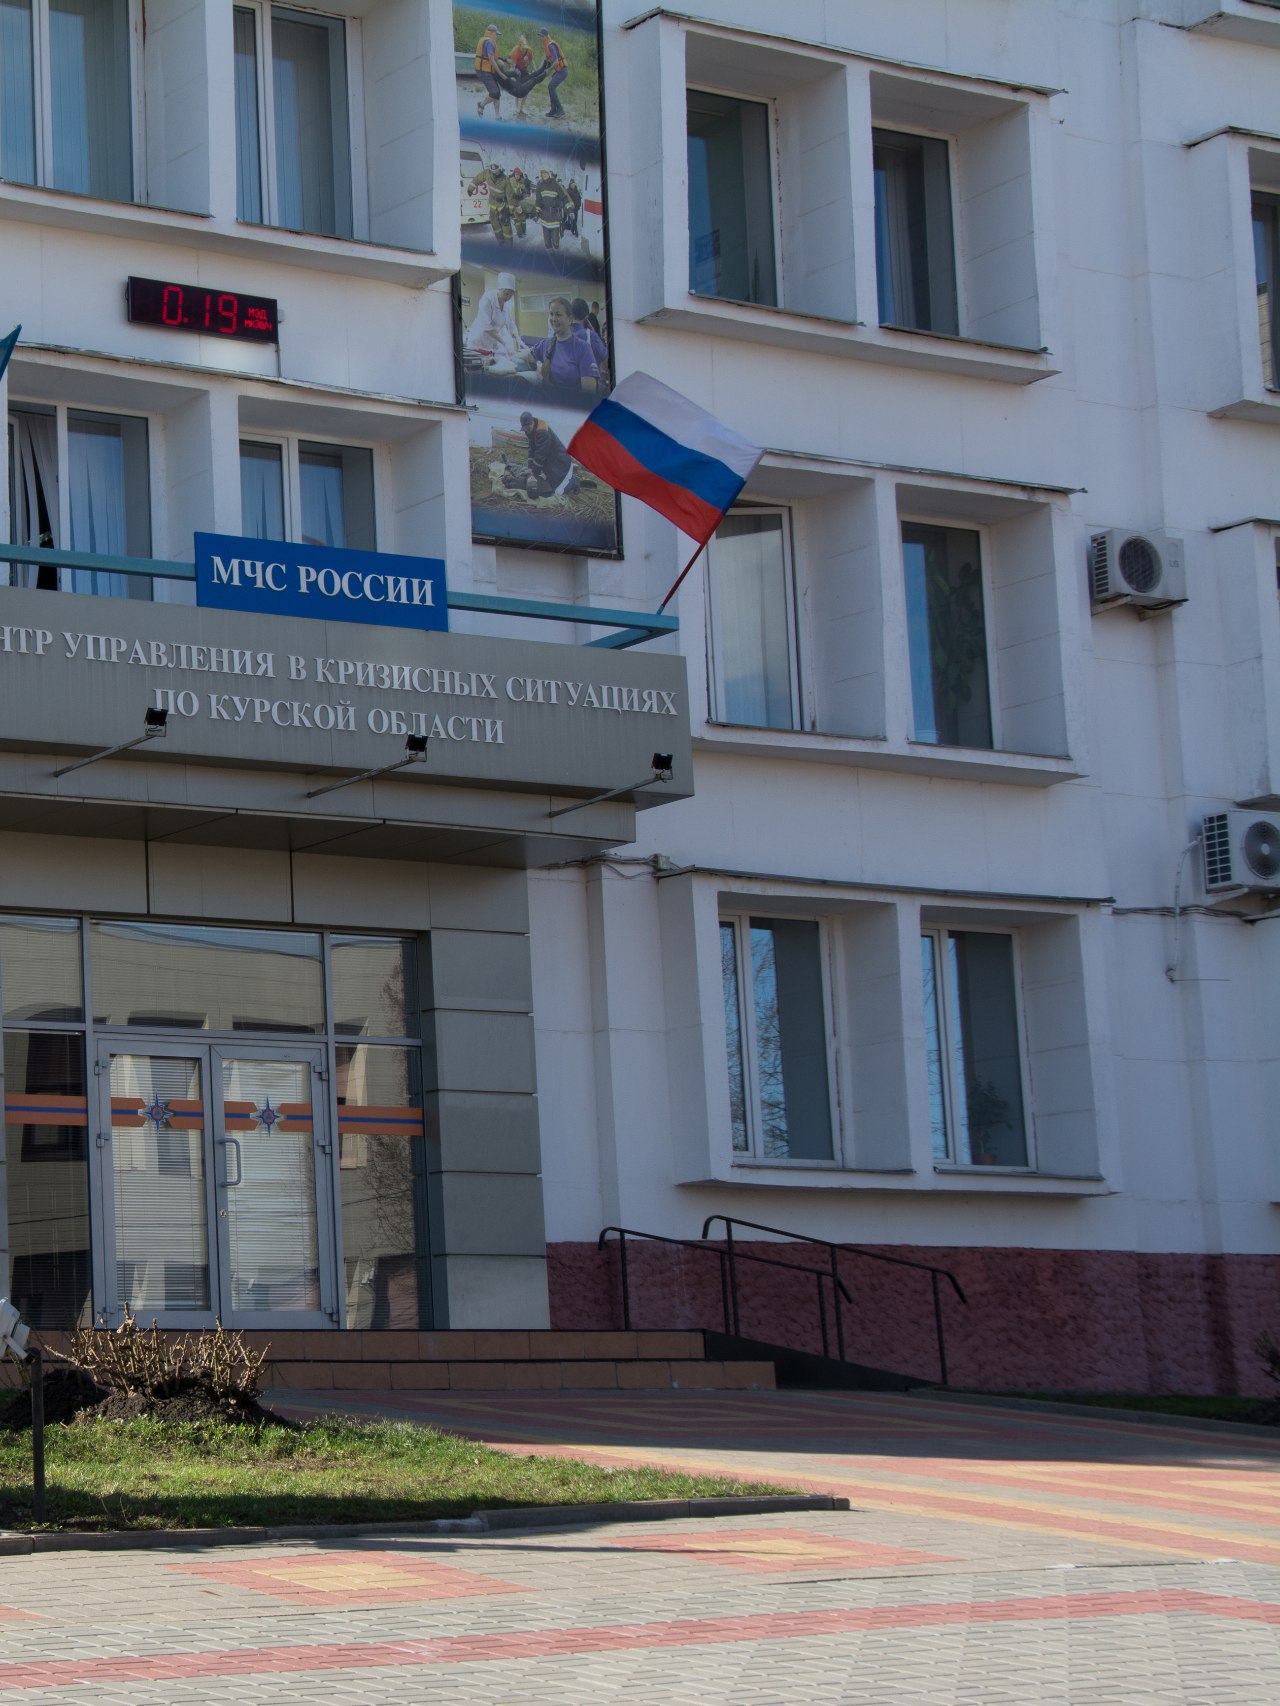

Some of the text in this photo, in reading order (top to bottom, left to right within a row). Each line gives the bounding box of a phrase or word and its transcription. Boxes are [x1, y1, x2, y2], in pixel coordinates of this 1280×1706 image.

[162, 286, 238, 334] 0.19
[248, 307, 268, 319] МЭД
[210, 555, 436, 607] МЧС РОССИИ
[61, 632, 277, 679] УПРАВЛЕНИЯ
[288, 655, 307, 681] В
[314, 657, 499, 700] КРИЗИСНЫХ
[505, 676, 679, 716] СИТУАЦИЯХ
[152, 688, 505, 745] ПО КУРСКОЙ ОБЛАСТИ
